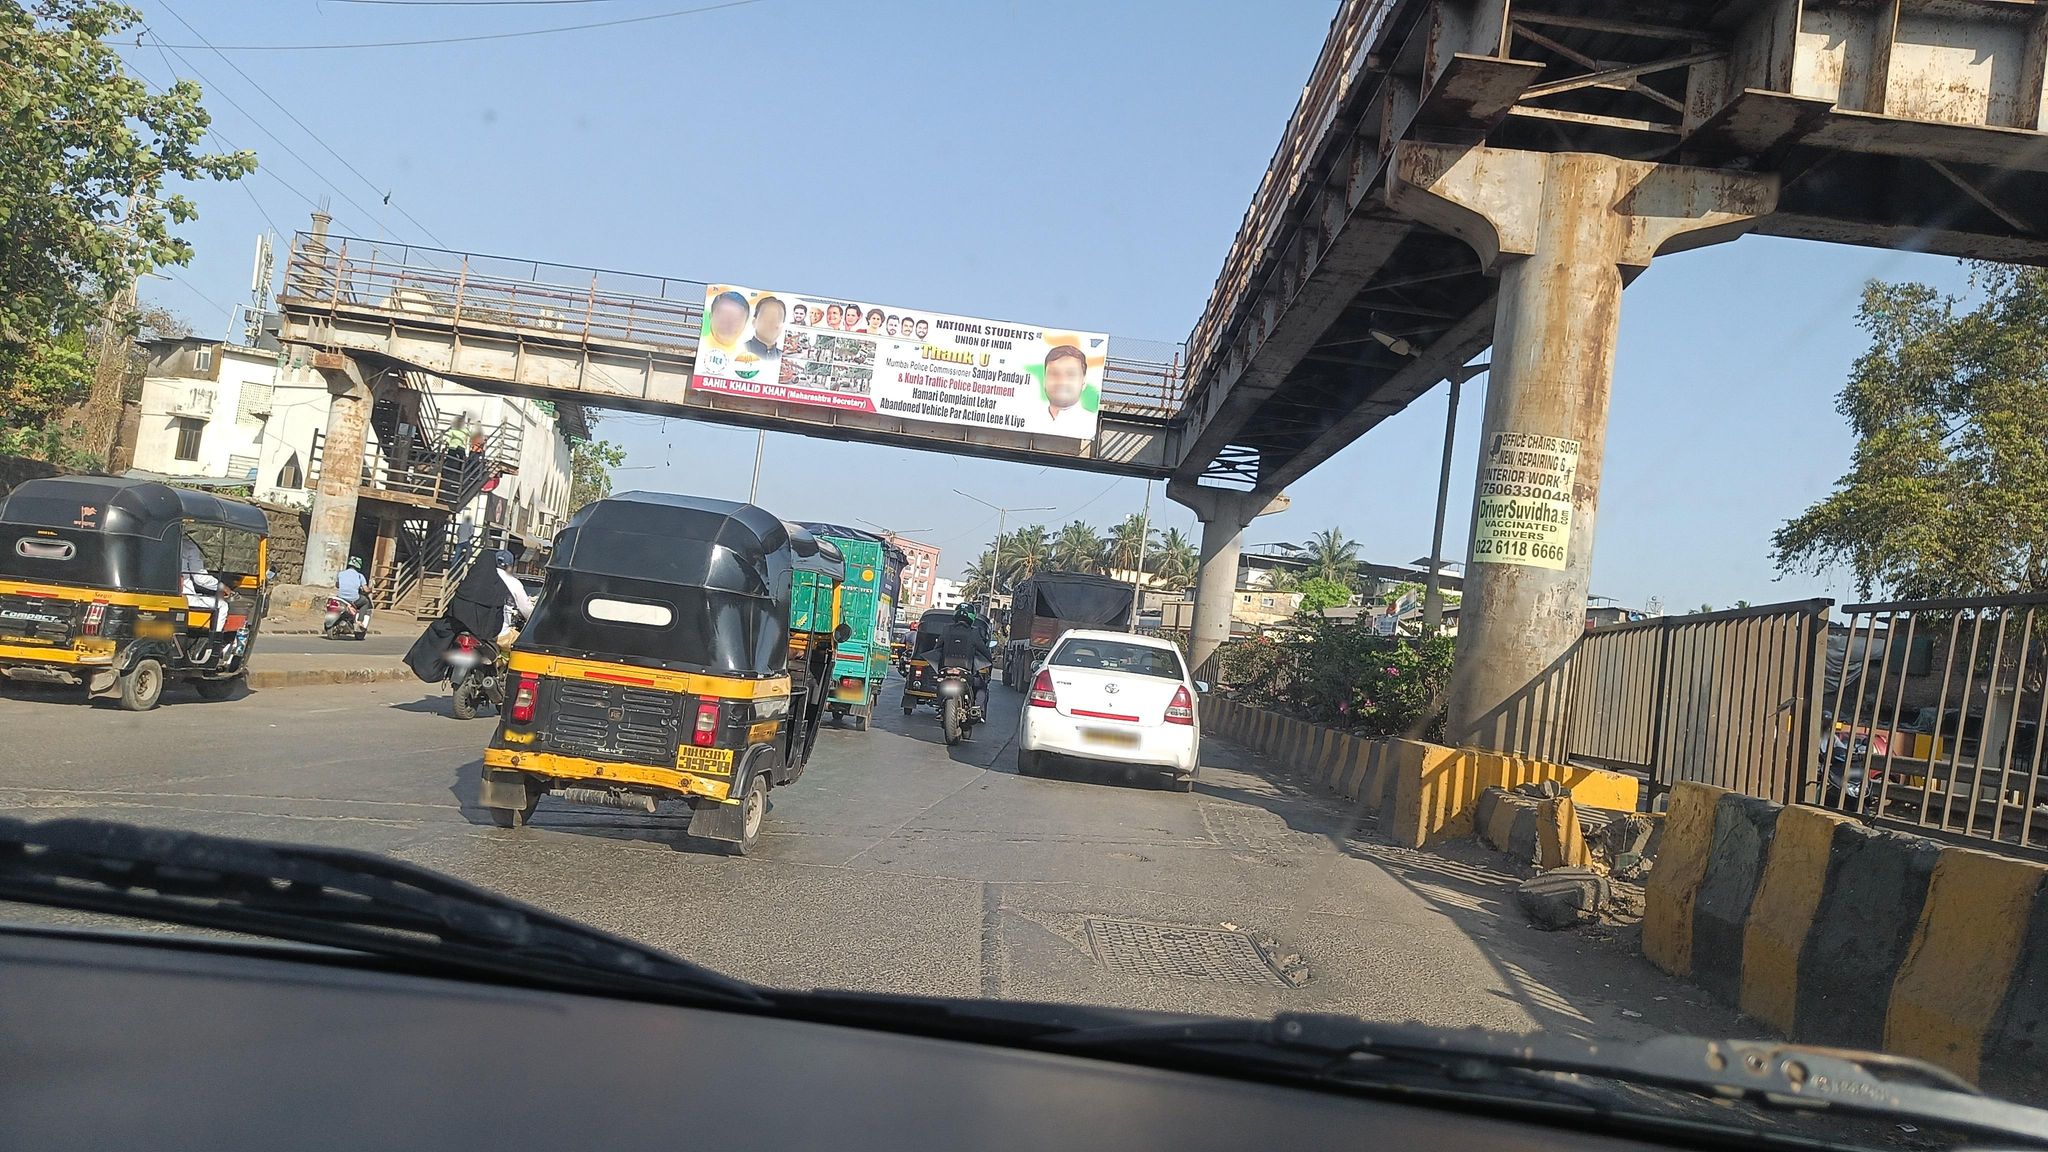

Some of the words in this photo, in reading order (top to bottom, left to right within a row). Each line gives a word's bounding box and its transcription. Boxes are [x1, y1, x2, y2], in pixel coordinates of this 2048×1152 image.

[936, 320, 982, 334] NATIONAL
[985, 326, 1034, 340] STUDENTS
[955, 335, 979, 346] UNION
[980, 338, 990, 348] OF
[991, 340, 1012, 350] INDIA
[921, 344, 974, 365] Thank
[979, 353, 991, 367] U
[886, 358, 909, 368] Mumbai
[910, 361, 928, 372] Police
[930, 364, 972, 377] Commissioner
[972, 366, 996, 384] Sanjay
[997, 370, 1024, 386] Panday
[1024, 373, 1030, 385] Ji
[702, 377, 728, 389] SAHIL
[728, 380, 761, 394] KHALID
[762, 385, 786, 398] KHAN
[787, 390, 832, 403] (Maharashtra
[832, 396, 866, 408] Secretary)
[898, 372, 903, 382] &
[904, 372, 924, 386] Kurla
[925, 374, 948, 388] Traffic
[948, 378, 971, 392] Police
[972, 381, 1014, 398] Department
[912, 388, 938, 402] Hamari
[940, 391, 975, 407] Complaint
[976, 395, 997, 410] Lekar
[880, 398, 920, 414] Abandoned
[921, 403, 948, 417] Vehicle
[949, 408, 962, 419] Par
[962, 409, 986, 422] Action
[986, 412, 1004, 425] Lene
[1004, 414, 1010, 426] K
[1010, 416, 1026, 428] Liye
[1502, 434, 1526, 448] OFFICE
[1560, 440, 1578, 456] SOFA
[1560, 457, 1566, 472] &
[1484, 468, 1526, 482] INTERIOR
[1528, 471, 1560, 489] WORK
[1482, 482, 1570, 502] 7506330048
[1485, 520, 1557, 532] VACCINATED
[1492, 530, 1544, 540] DRIVERS
[1475, 540, 1492, 554] 022
[1496, 540, 1528, 556] 6118
[1532, 543, 1564, 560] 6666
